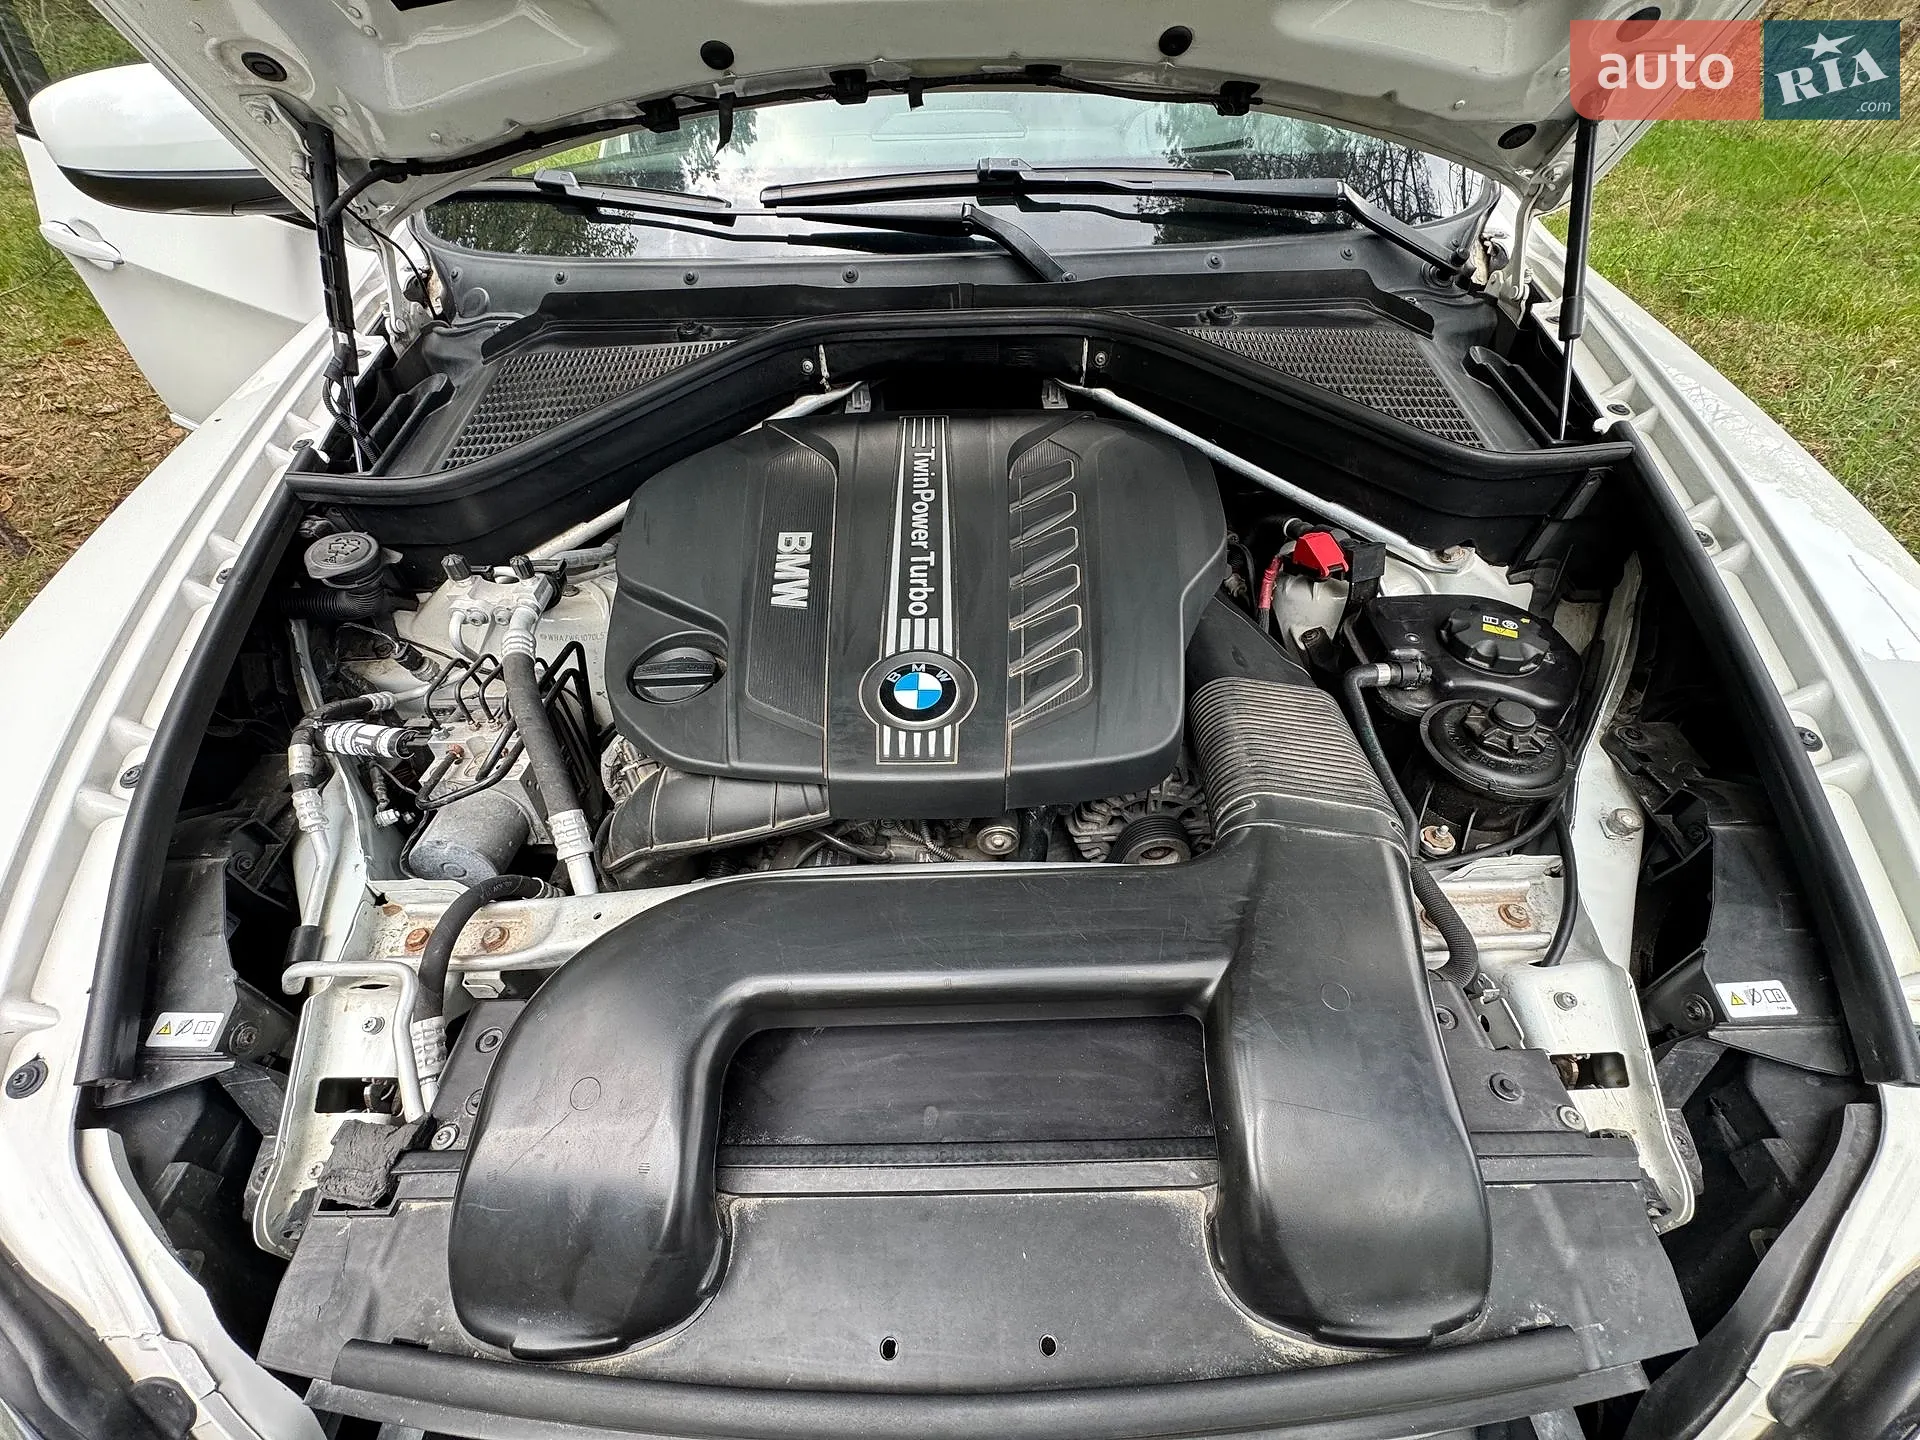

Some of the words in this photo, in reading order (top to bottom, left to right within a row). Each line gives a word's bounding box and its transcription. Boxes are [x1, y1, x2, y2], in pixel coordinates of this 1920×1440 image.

[910, 449, 937, 550] TwinPower
[770, 531, 813, 609] BMW
[907, 551, 936, 616] Turbo
[886, 663, 952, 683] BMW
